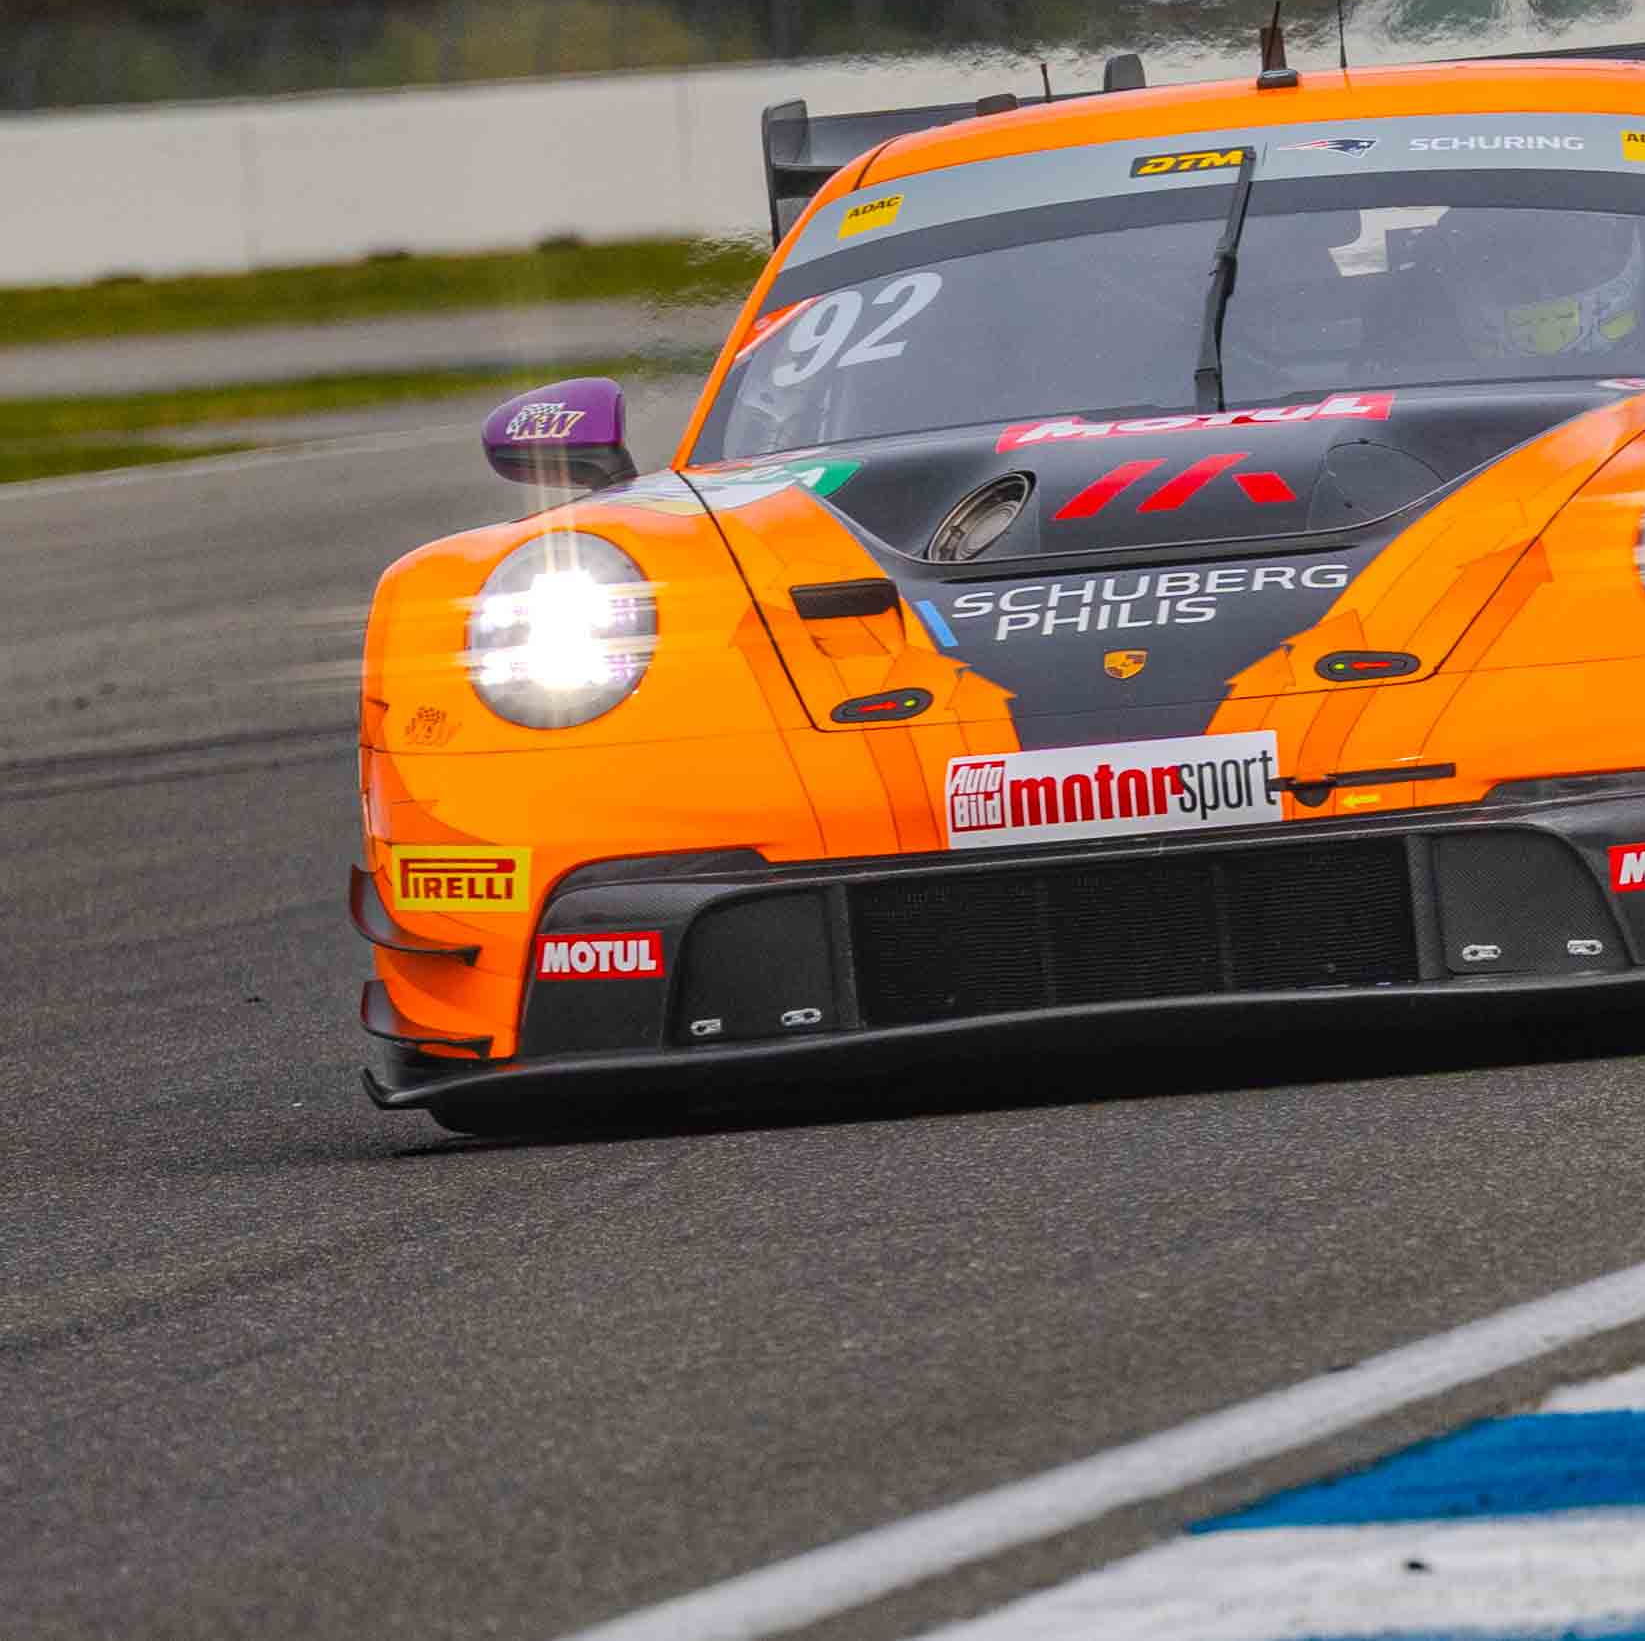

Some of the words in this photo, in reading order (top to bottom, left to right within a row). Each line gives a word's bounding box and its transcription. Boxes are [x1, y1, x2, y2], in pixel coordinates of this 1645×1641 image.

[1408, 134, 1585, 152] SCHURING
[1136, 149, 1245, 175] DTM
[847, 196, 901, 219] ADAC
[772, 272, 943, 387] 92
[1014, 396, 1374, 444] MOTUL
[951, 564, 1351, 619] SCHUBERG
[995, 596, 1218, 642] PHILIS
[952, 763, 1003, 794] Auto
[954, 791, 1002, 828] Bild
[400, 858, 516, 899] PIRELLI
[541, 939, 657, 974] MOTUL
